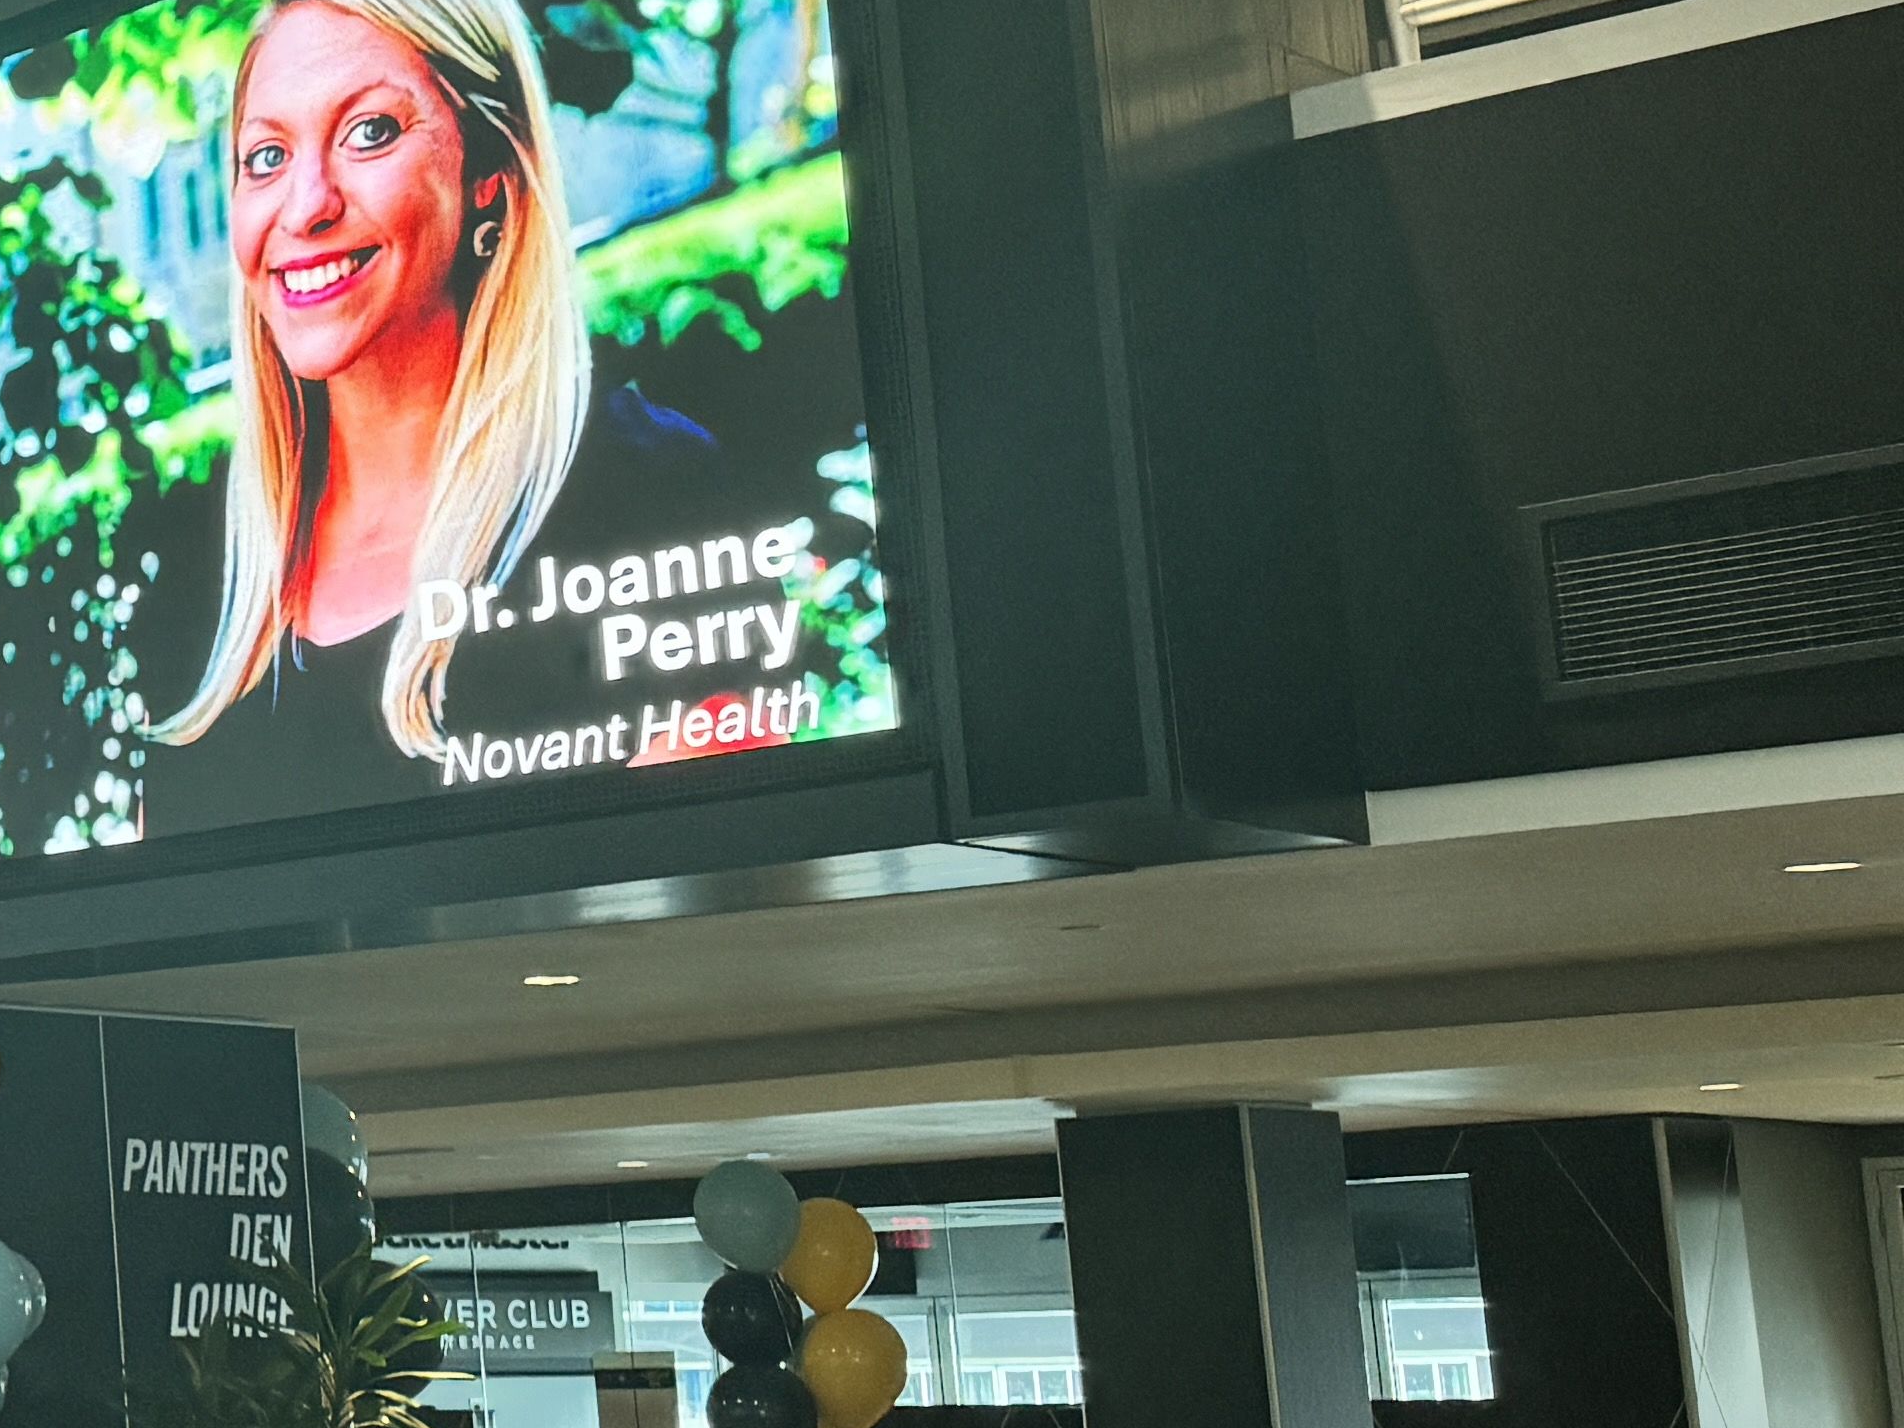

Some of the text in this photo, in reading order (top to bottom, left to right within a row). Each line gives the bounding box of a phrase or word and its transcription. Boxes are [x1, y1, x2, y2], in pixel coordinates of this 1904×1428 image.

[416, 524, 798, 642] Dr. Joanne
[601, 598, 800, 681] Perry
[442, 680, 820, 786] Novant Health
[123, 1137, 289, 1199] PANTHERS
[229, 1212, 293, 1268] DEN
[507, 1299, 591, 1330] CLUB
